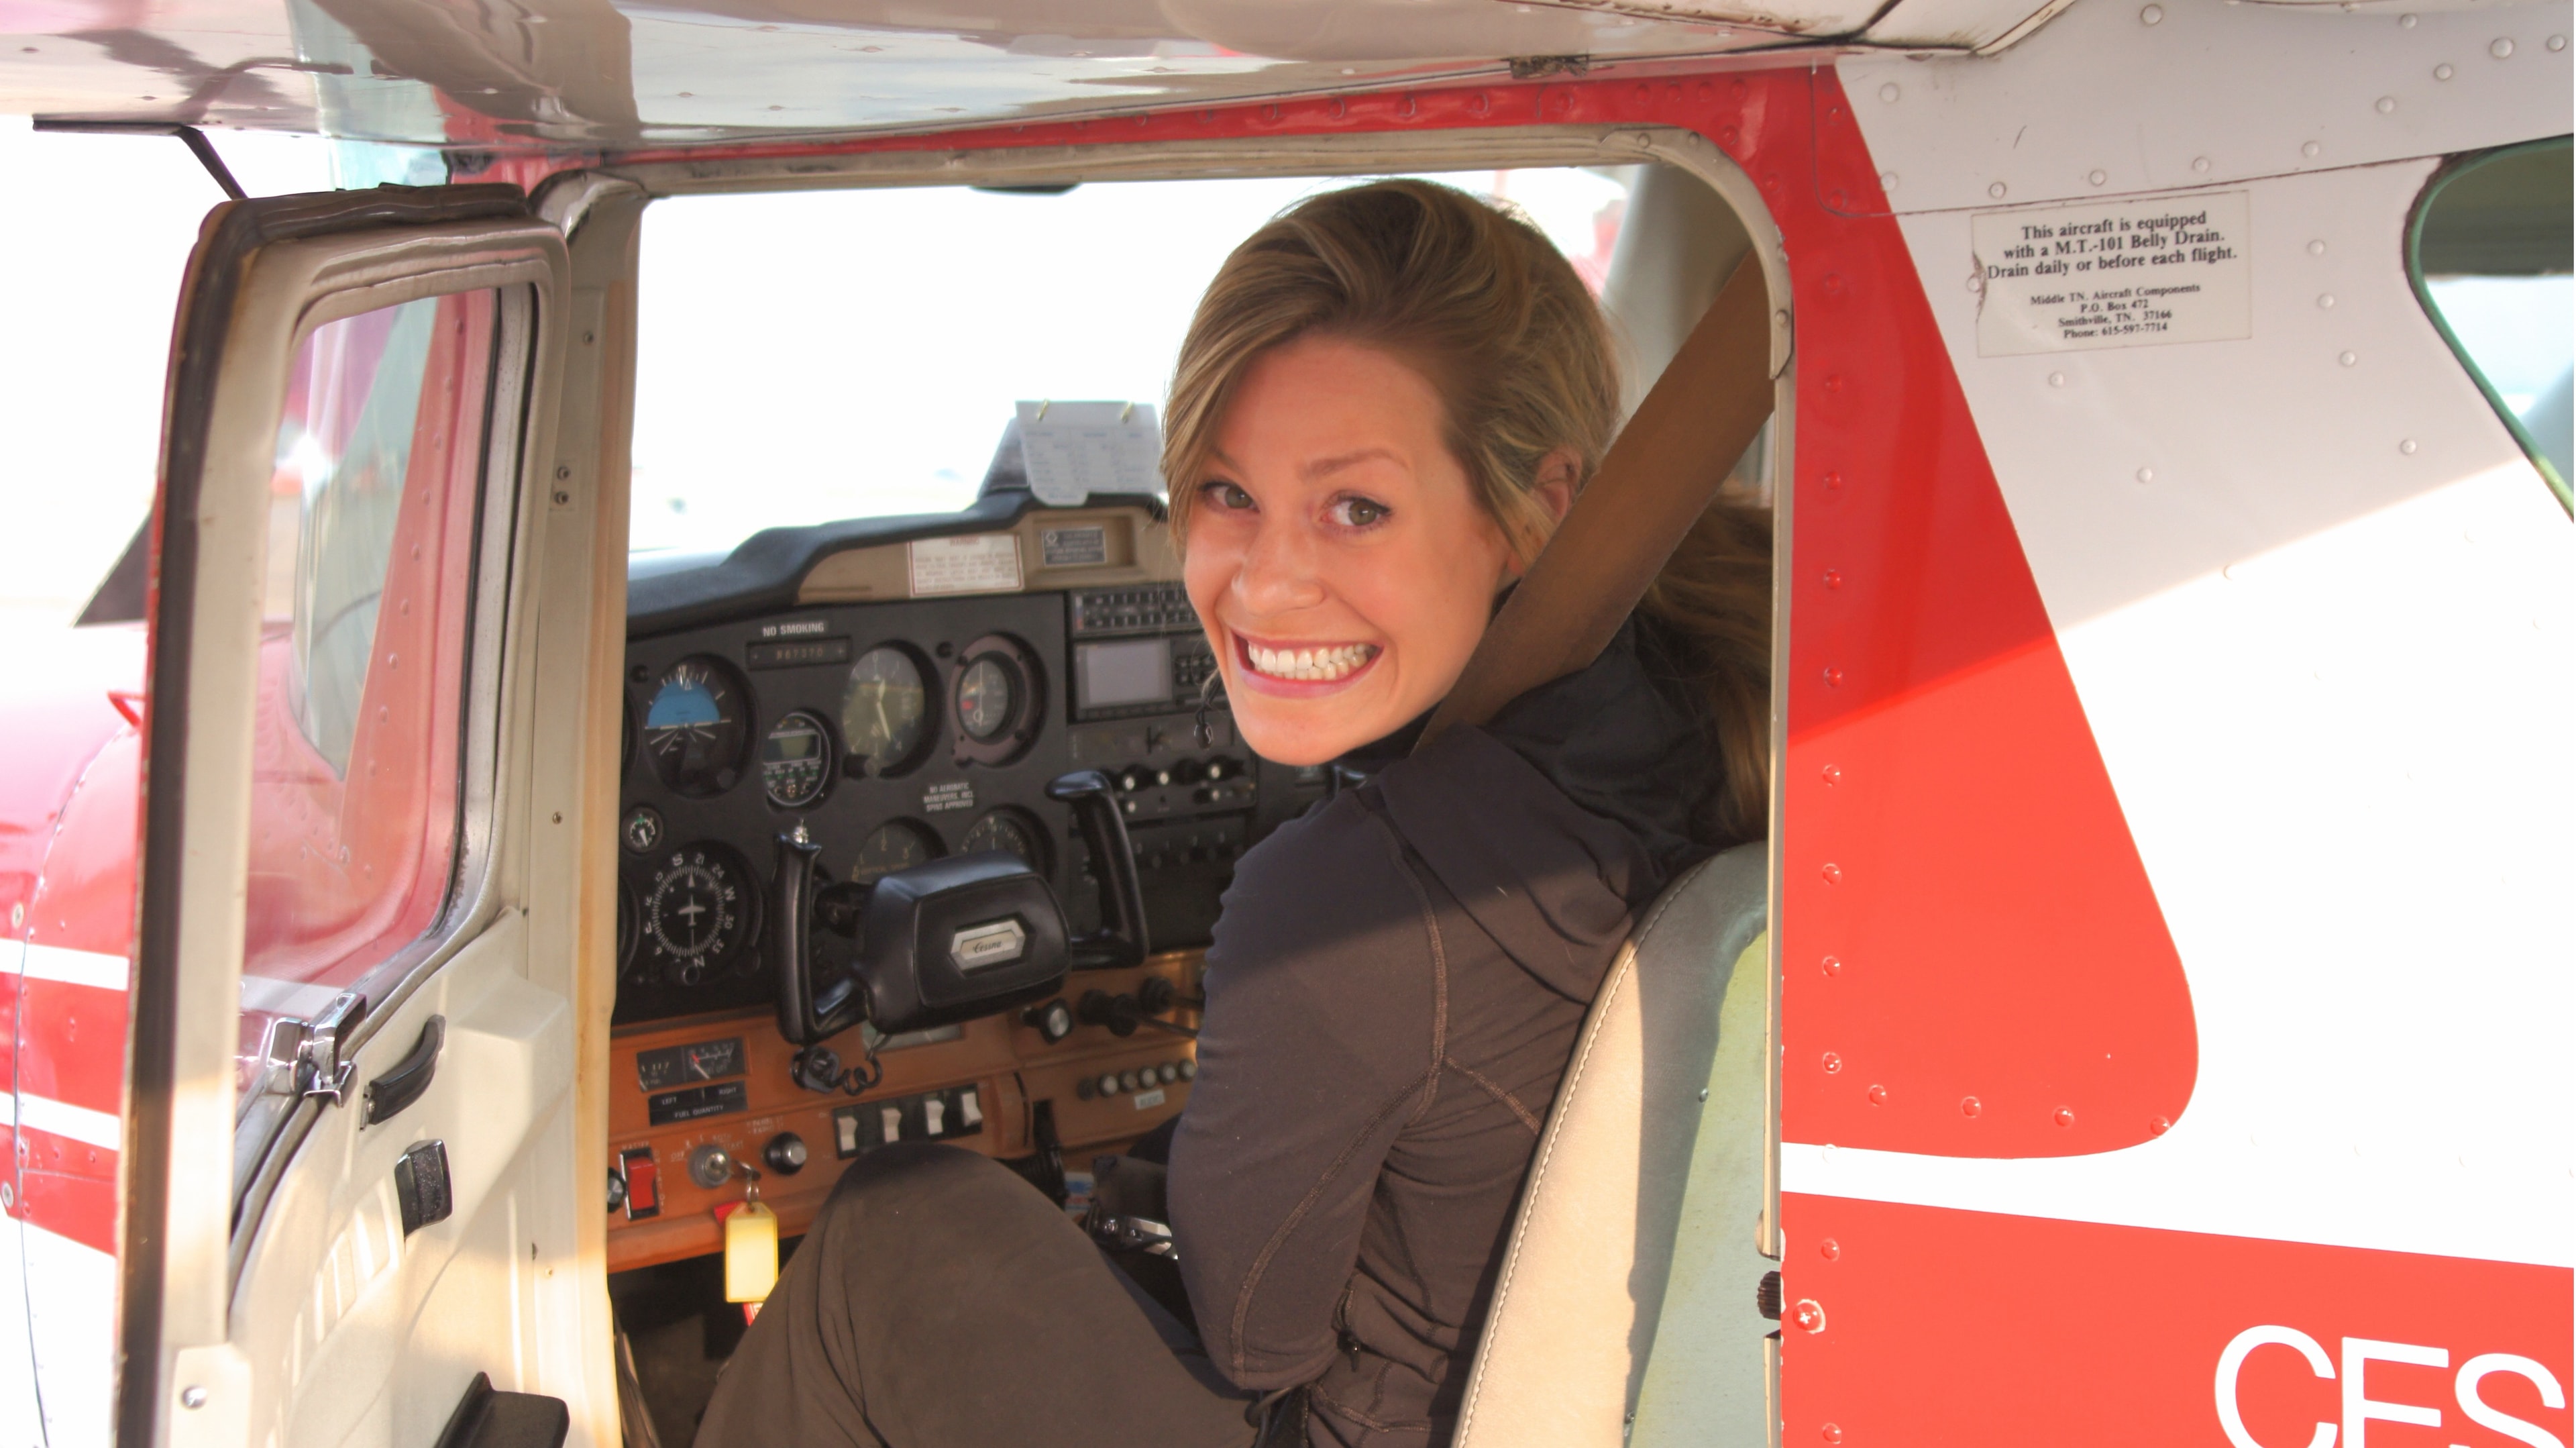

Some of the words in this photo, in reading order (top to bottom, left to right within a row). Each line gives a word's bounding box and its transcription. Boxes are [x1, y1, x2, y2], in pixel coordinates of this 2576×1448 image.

[2022, 223, 2053, 240] This
[2059, 219, 2112, 237] aircraft
[2120, 217, 2131, 231] is
[2137, 210, 2207, 231] equipped
[2004, 245, 2035, 259] with
[2041, 247, 2049, 256] a
[2055, 237, 2123, 255] M.T.-101
[2131, 231, 2168, 249] Belly
[2175, 229, 2225, 245] Drain.
[1988, 264, 2029, 279] Drain
[2035, 260, 2070, 276] daily
[2076, 262, 2092, 271] or
[2098, 254, 2145, 270] before
[2151, 250, 2186, 264] each
[2192, 246, 2237, 264] flight.
[2031, 294, 2065, 305] Middle
[2070, 292, 2088, 301] TN.
[2093, 288, 2131, 299] Aircraft
[2137, 284, 2200, 297] Components
[2081, 303, 2103, 313] P.O.
[2108, 301, 2127, 311] Box
[2132, 299, 2148, 308] 472
[2058, 315, 2111, 327] Smithville,
[2116, 313, 2135, 323] TN.
[2143, 309, 2173, 320] 37166
[2064, 329, 2098, 338] Phone:
[763, 626, 777, 637] NO
[780, 622, 824, 635] SMOKING
[973, 941, 1004, 953] Cessna
[719, 1087, 737, 1095] RIGHT
[662, 1097, 677, 1106] LEFT
[675, 1110, 690, 1119] FUEL
[693, 1105, 724, 1116] QUANTITY
